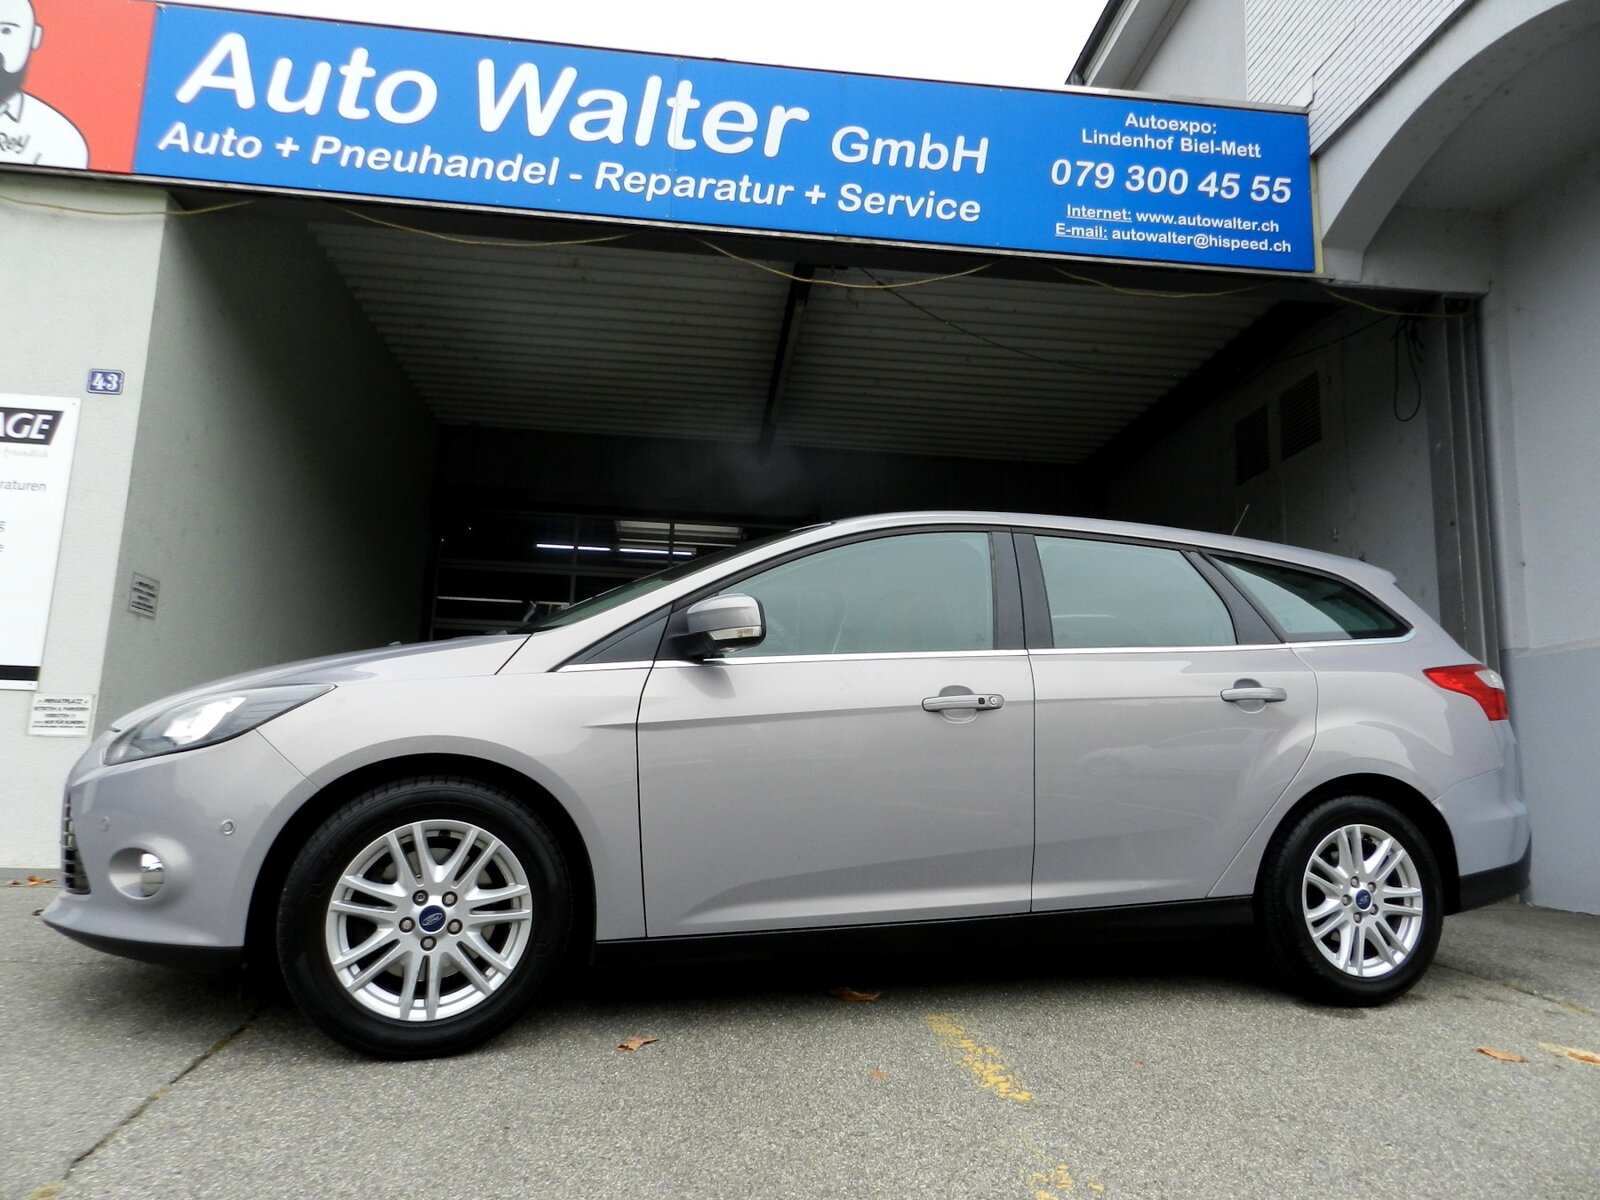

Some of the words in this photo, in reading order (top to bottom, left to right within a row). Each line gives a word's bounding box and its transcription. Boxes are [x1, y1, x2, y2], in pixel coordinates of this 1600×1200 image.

[175, 31, 438, 125] Auto
[477, 57, 810, 158] Walter
[831, 125, 989, 174] GmbH
[1125, 113, 1217, 135] Autoexpo:
[1081, 128, 1174, 151] Lindenhof
[1180, 137, 1262, 158] Biel-Mett
[157, 121, 263, 159] Auto
[274, 136, 300, 158] +
[310, 135, 560, 186] Pneuhandel
[594, 161, 795, 206] Reparatur
[804, 184, 826, 205] +
[837, 183, 982, 222] Service
[1051, 158, 1115, 189] 079
[1125, 165, 1188, 195] 300
[1197, 171, 1240, 199] 45
[1250, 175, 1291, 203] 55
[1067, 204, 1133, 222] Internet:
[1136, 212, 1279, 232] www.autowalter.ch
[1055, 222, 1108, 240] E-mail:
[1112, 229, 1291, 252] autowalter@hispeed.ch
[92, 372, 119, 391] 43
[0, 411, 54, 440] GE
